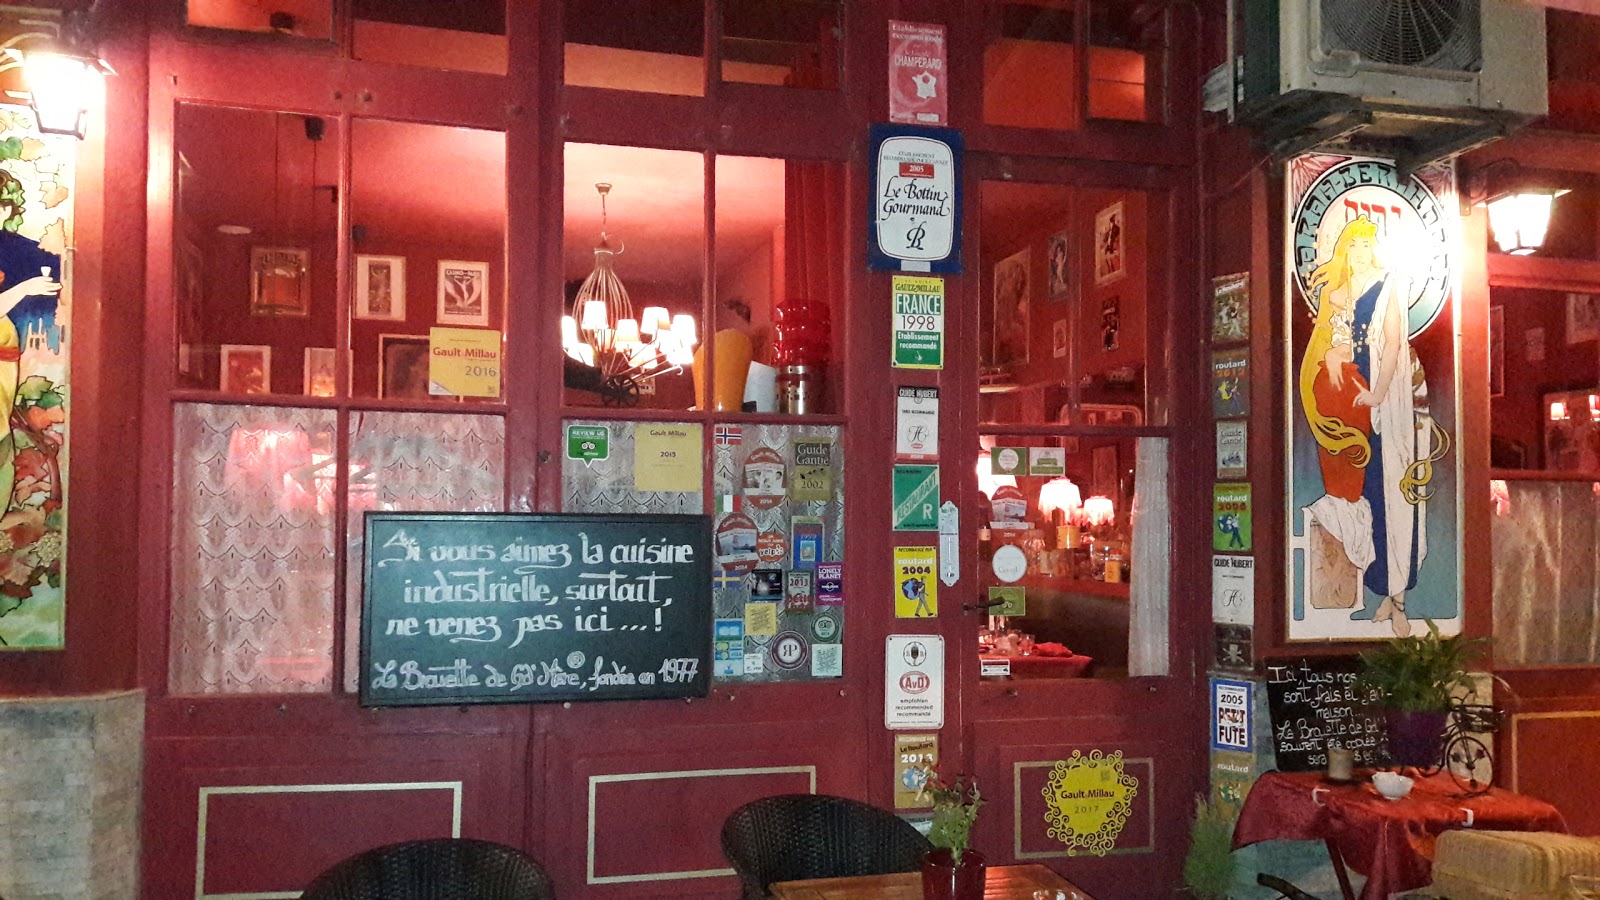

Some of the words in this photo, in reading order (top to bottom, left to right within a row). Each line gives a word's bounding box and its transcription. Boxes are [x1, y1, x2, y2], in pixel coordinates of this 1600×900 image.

[909, 165, 924, 173] 2005
[883, 175, 901, 198] Le
[903, 178, 949, 202] Bottin
[881, 198, 951, 221] Gourmand
[896, 294, 941, 315] FRANCE
[902, 315, 935, 331] 1998
[897, 332, 939, 341] Etablissement
[899, 342, 938, 350] recommandé
[432, 347, 461, 357] Gault
[464, 348, 497, 359] Millau
[1215, 359, 1246, 370] routard
[465, 366, 497, 377] 2016
[797, 443, 828, 455] Guide
[801, 480, 824, 489] 2002
[1217, 494, 1247, 502] routard
[923, 503, 933, 520] R
[428, 543, 497, 562] vous
[578, 532, 604, 565] la
[610, 537, 695, 565] cuisine
[759, 548, 777, 556] yelp
[898, 557, 933, 565] routard
[1214, 558, 1231, 568] GUIDE
[1231, 558, 1253, 568] HUBERT
[902, 566, 931, 575] 2004
[403, 567, 559, 606] industrielle,
[385, 617, 421, 636] ne
[425, 616, 503, 643] venez
[508, 613, 563, 649] pas
[484, 664, 508, 688] de
[588, 656, 636, 692] fondée
[638, 671, 656, 686] en
[658, 657, 699, 683] 1977
[1300, 658, 1334, 683] tous
[1337, 671, 1358, 684] nos
[904, 676, 925, 689] AvD
[1220, 694, 1243, 705] 2005
[1283, 681, 1311, 704] sont
[1310, 684, 1342, 709] frais
[1218, 707, 1246, 724] PETIT
[1348, 717, 1363, 735] de
[1279, 738, 1324, 753] souvent
[1217, 763, 1249, 774] routard
[1060, 789, 1086, 800] Gault
[1087, 789, 1116, 799] Millau
[1074, 805, 1100, 814] 2017
